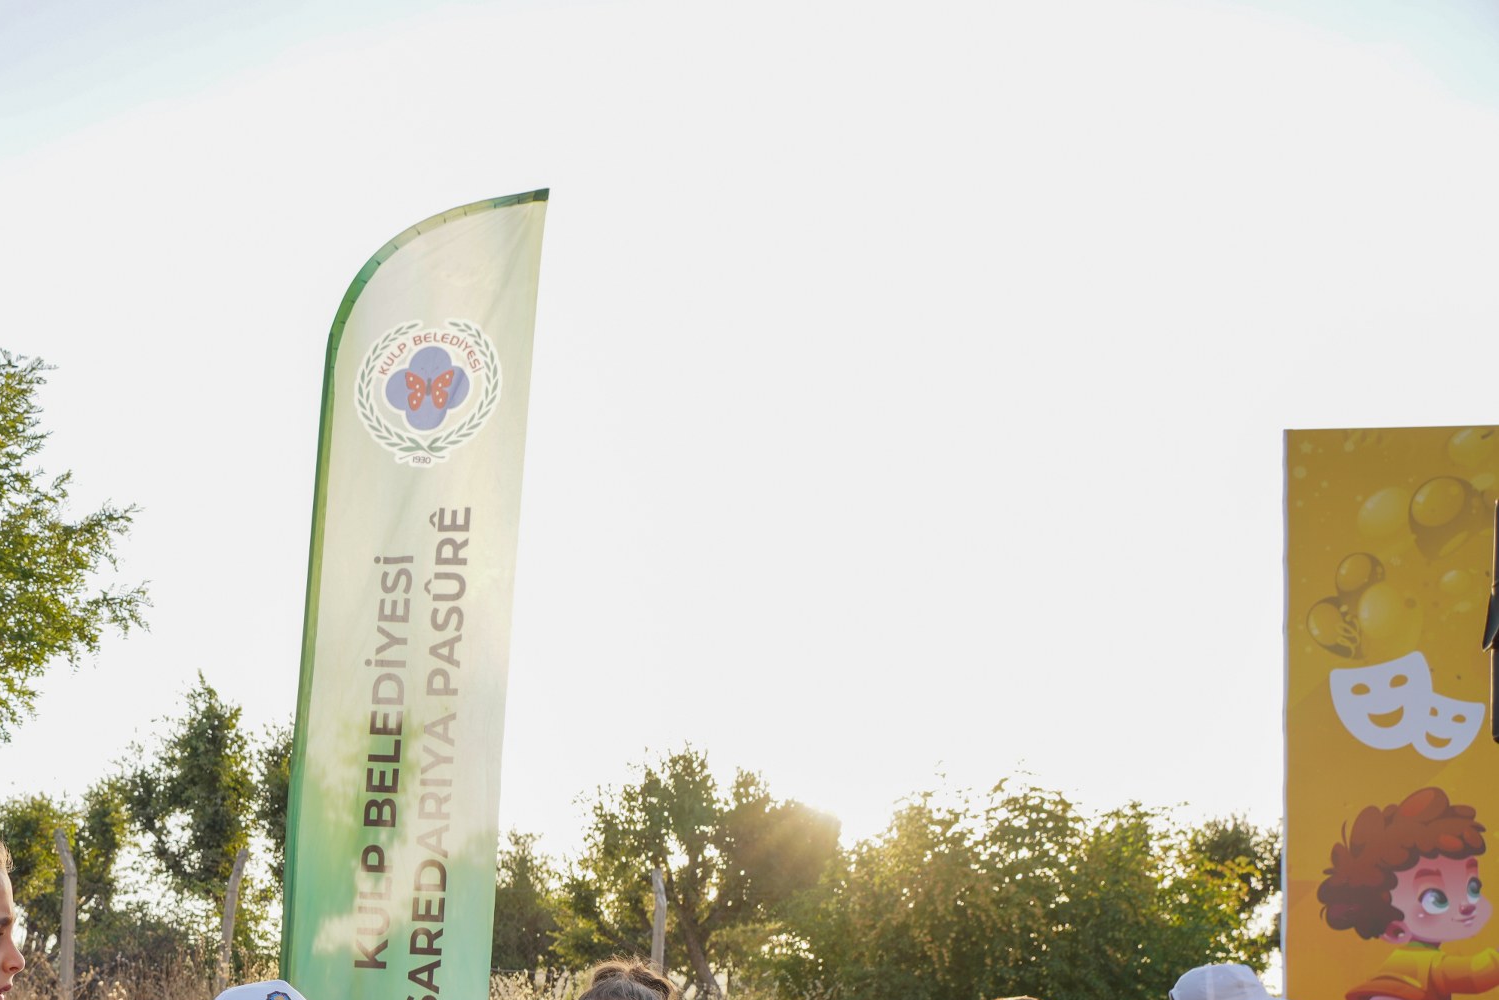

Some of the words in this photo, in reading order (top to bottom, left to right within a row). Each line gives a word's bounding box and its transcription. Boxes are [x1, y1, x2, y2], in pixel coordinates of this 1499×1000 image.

[378, 342, 407, 376] KULP
[412, 332, 484, 374] BELEDİYESİ
[412, 456, 431, 465] 1930
[424, 507, 471, 696] PASÛRÊ
[363, 555, 414, 828] BELEDİYESİ
[354, 844, 393, 970] KULP
